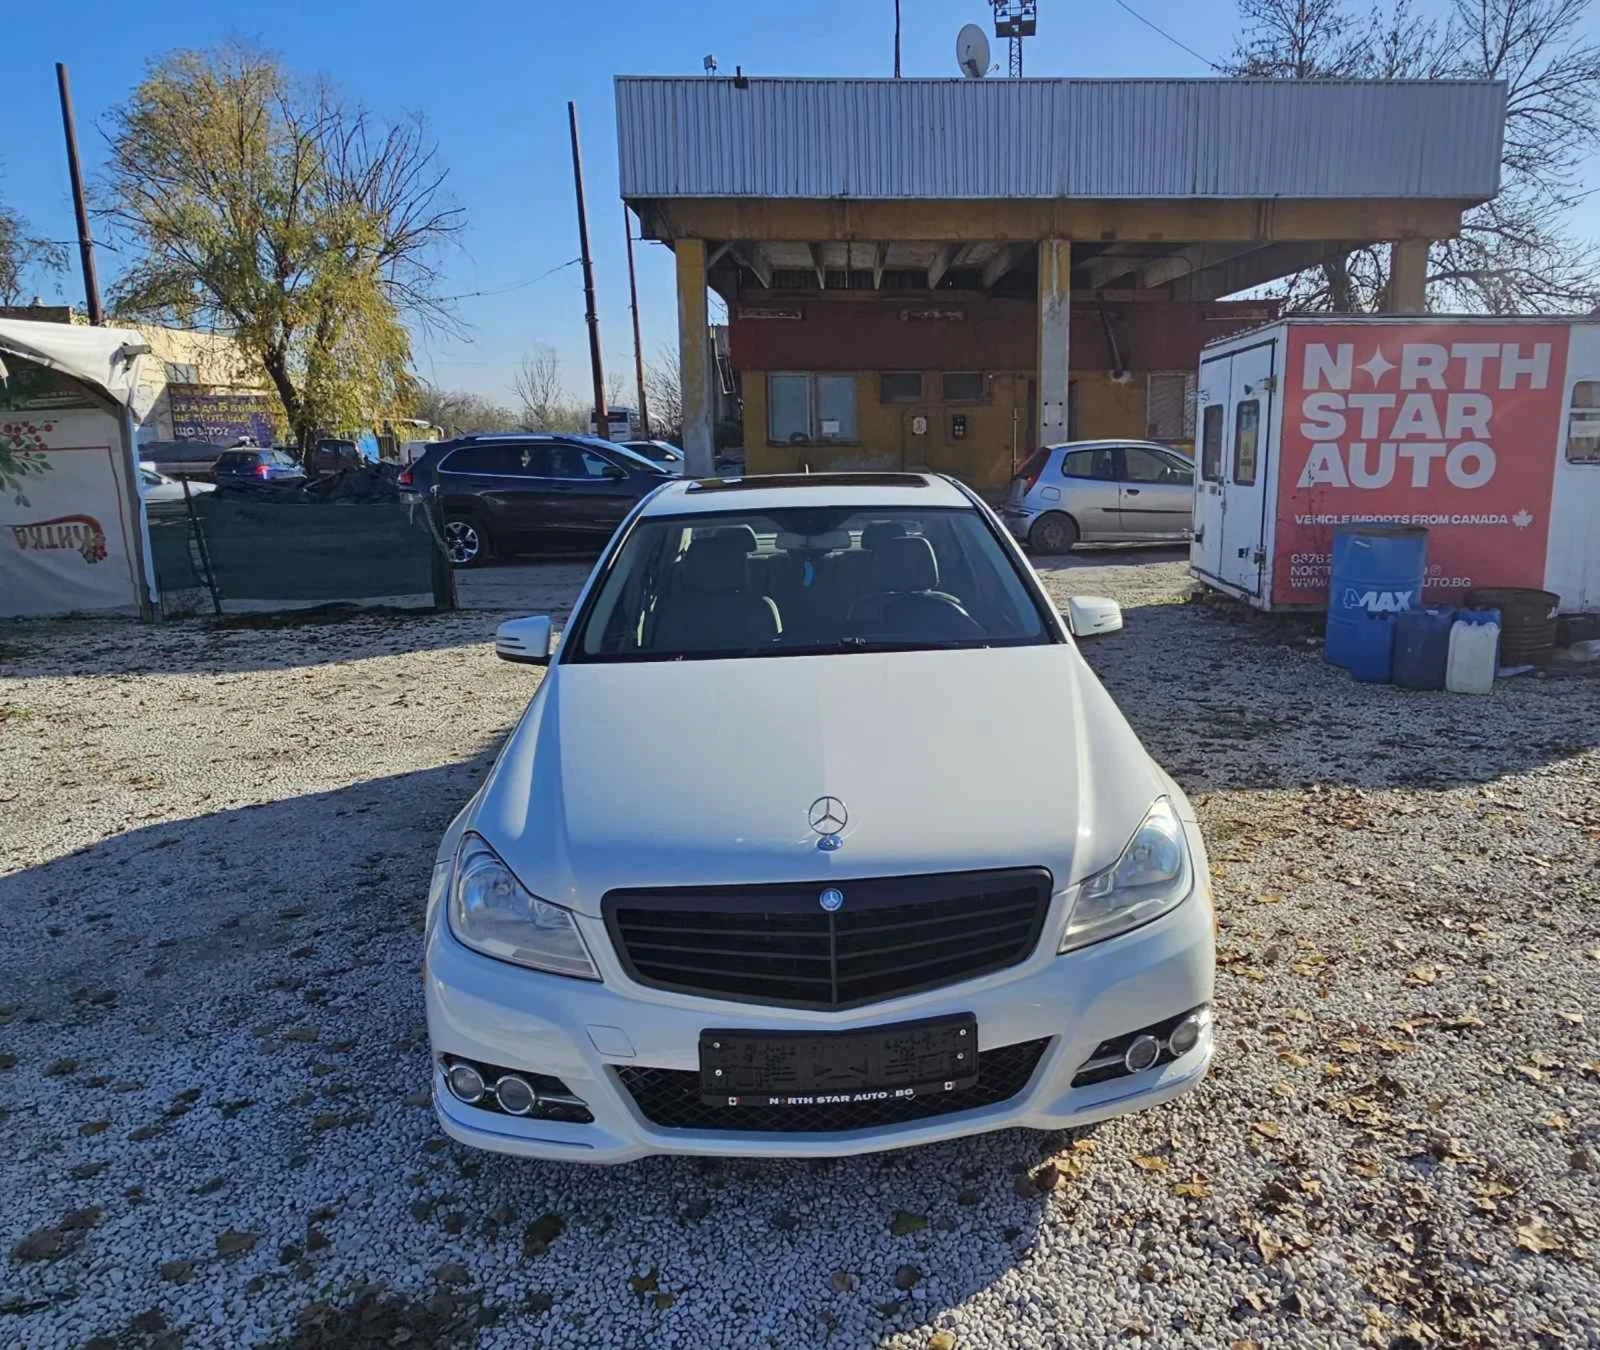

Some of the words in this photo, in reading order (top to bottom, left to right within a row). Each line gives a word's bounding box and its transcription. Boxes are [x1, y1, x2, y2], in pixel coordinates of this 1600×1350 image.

[1300, 392, 1493, 440] STAR
[1296, 441, 1496, 489] AUTO
[1294, 514, 1350, 525] VEHICLE
[1411, 514, 1449, 525] FROM
[1450, 514, 1508, 525] CANADA
[816, 1095, 850, 1104] STAR
